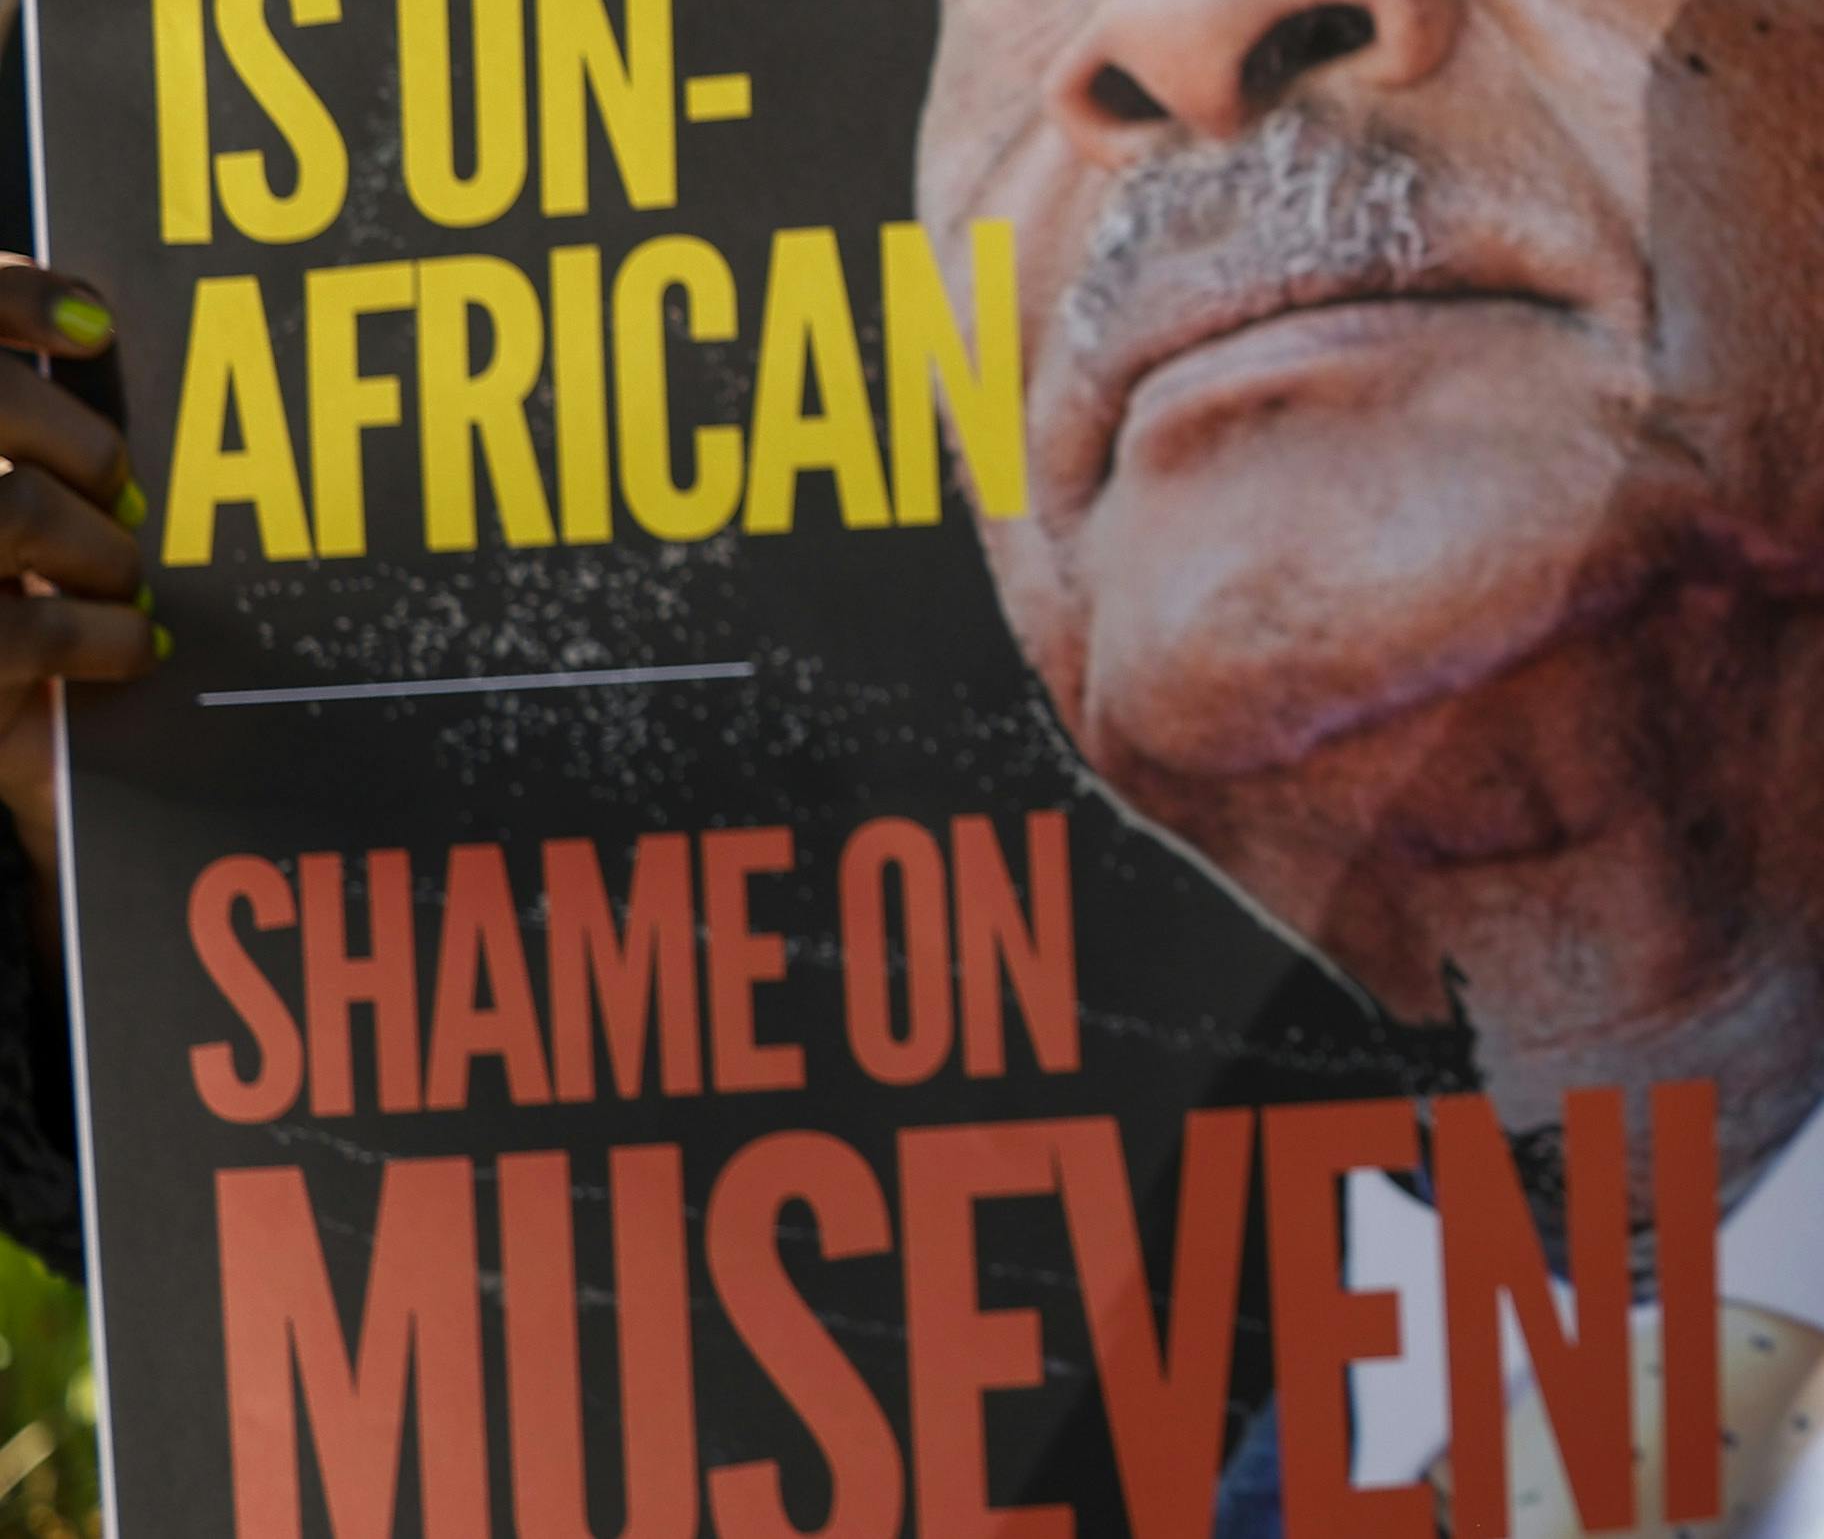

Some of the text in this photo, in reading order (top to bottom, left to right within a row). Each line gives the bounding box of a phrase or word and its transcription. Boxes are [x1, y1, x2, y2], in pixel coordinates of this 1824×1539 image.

[161, 219, 1028, 569] AFRICAN
[187, 810, 1082, 1124] SHAME ON
[215, 1079, 1722, 1539] MUSEVENI
